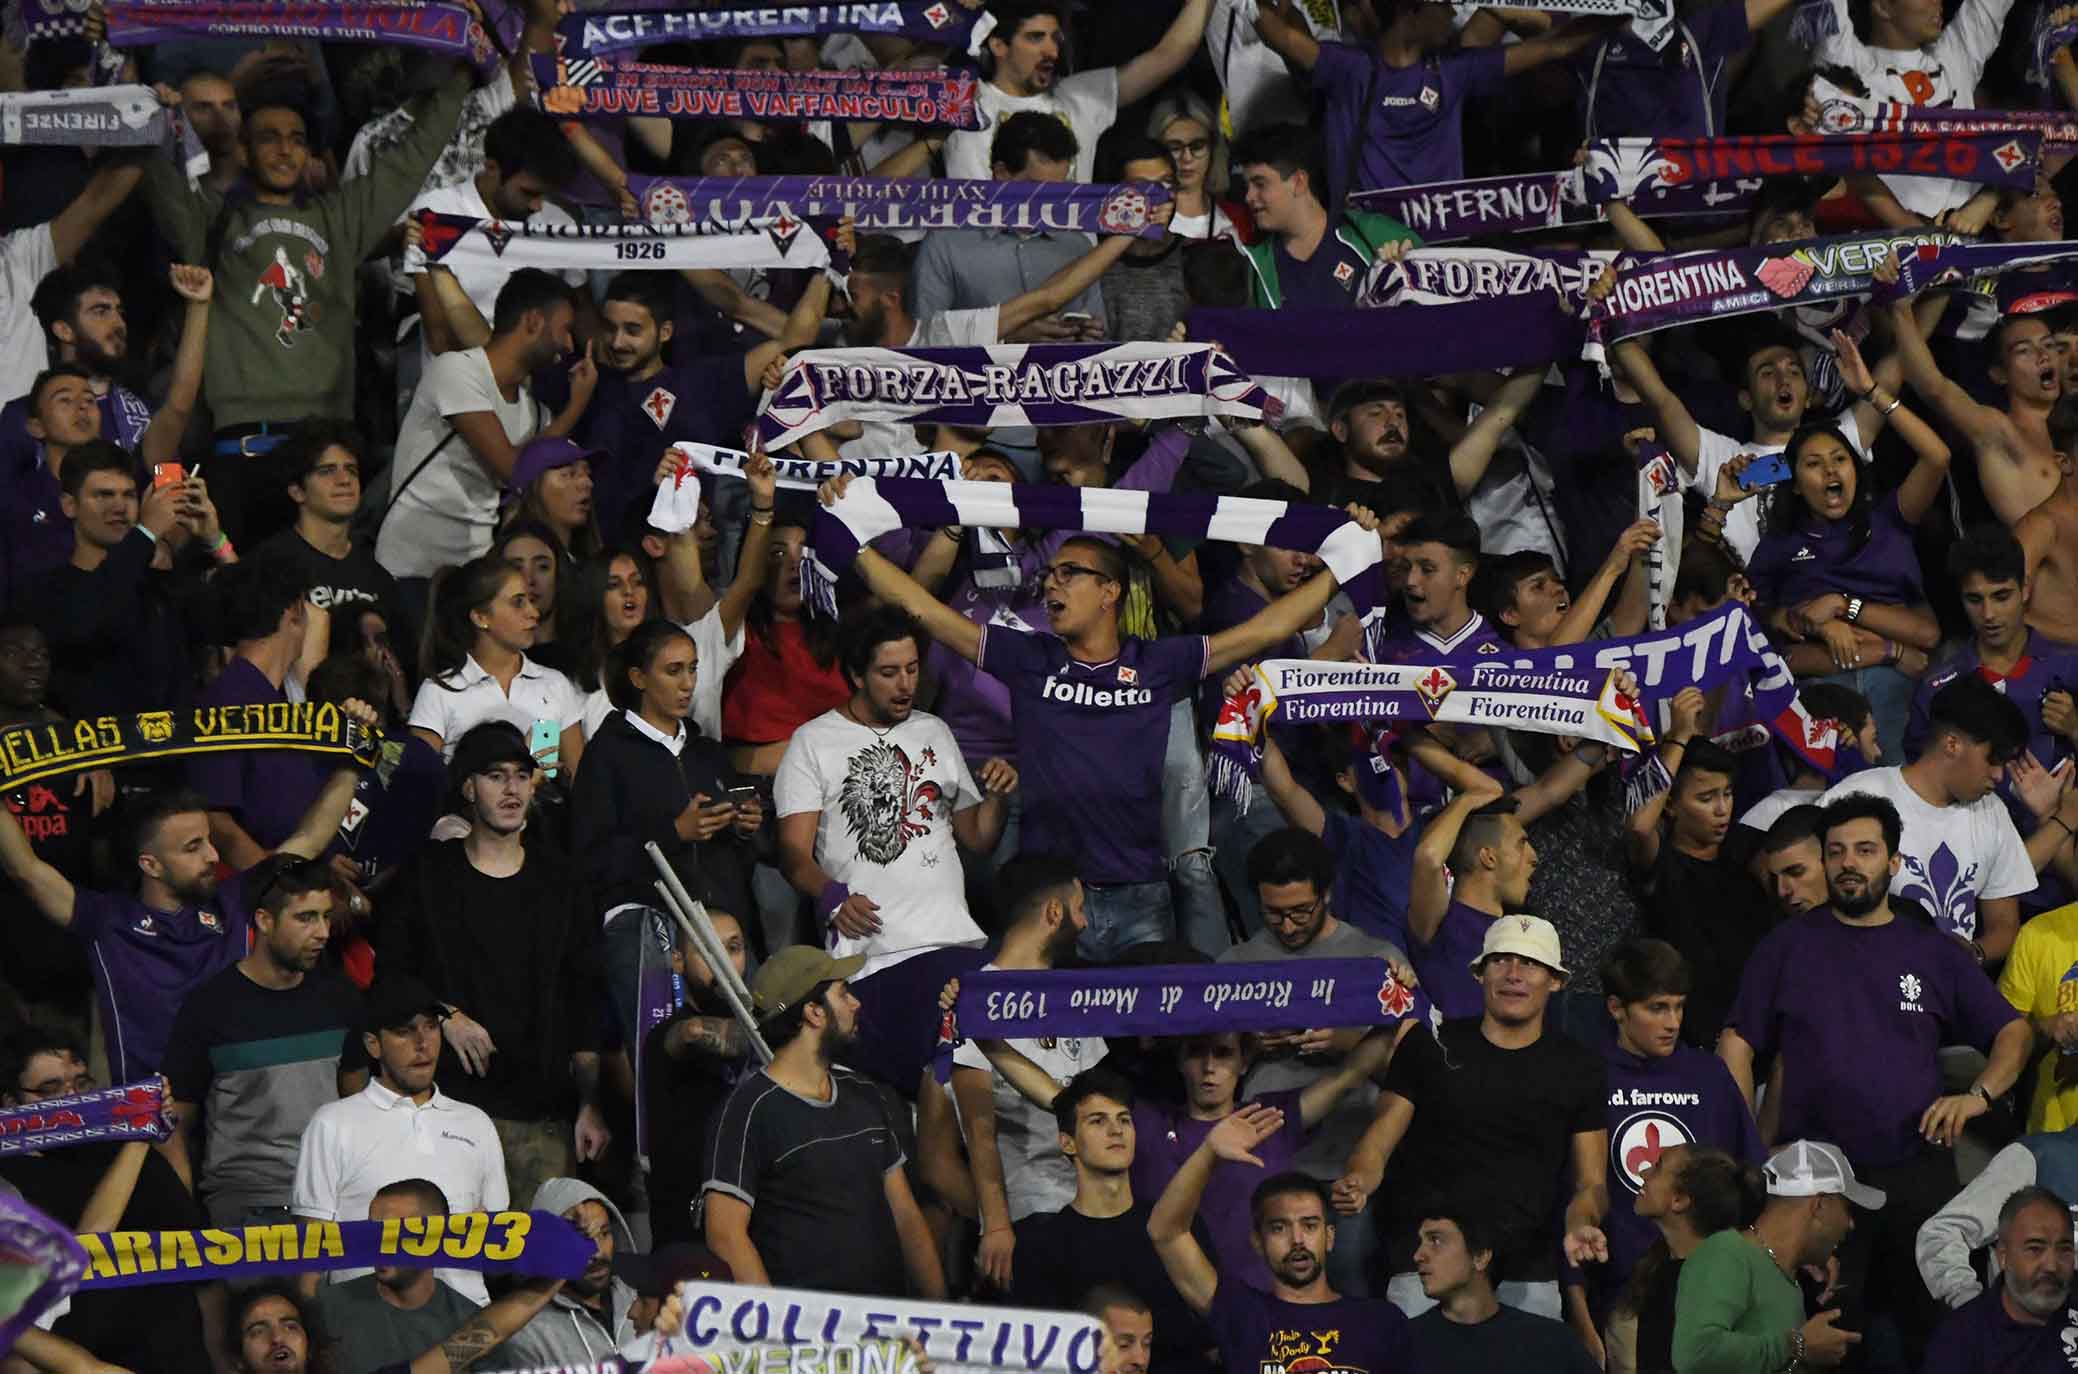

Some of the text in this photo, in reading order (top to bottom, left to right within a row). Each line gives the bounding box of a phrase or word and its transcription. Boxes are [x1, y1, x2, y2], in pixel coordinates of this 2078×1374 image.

[271, 25, 320, 37] TUTTO
[336, 26, 376, 39] TUTTI
[25, 112, 120, 131] FIRENZE
[585, 87, 937, 123] JUVE JUVE VAFFANCULO
[1659, 134, 1825, 184] SINCE
[1400, 182, 1549, 231] INFERNO
[613, 241, 667, 260] 1926
[1412, 258, 1567, 299] FORZA
[1710, 291, 1770, 312] AMICI
[815, 353, 1193, 405] FORZA RAGAZZI
[1280, 667, 1591, 695] Fiorentina Fiorentina
[193, 701, 341, 743] VERONA
[1286, 695, 1586, 726] Fiorentina Fiorentina
[986, 978, 1336, 1022] In Ricordo di Mario 1993
[1630, 1088, 1700, 1106] farrow's
[376, 1210, 532, 1261] 1993
